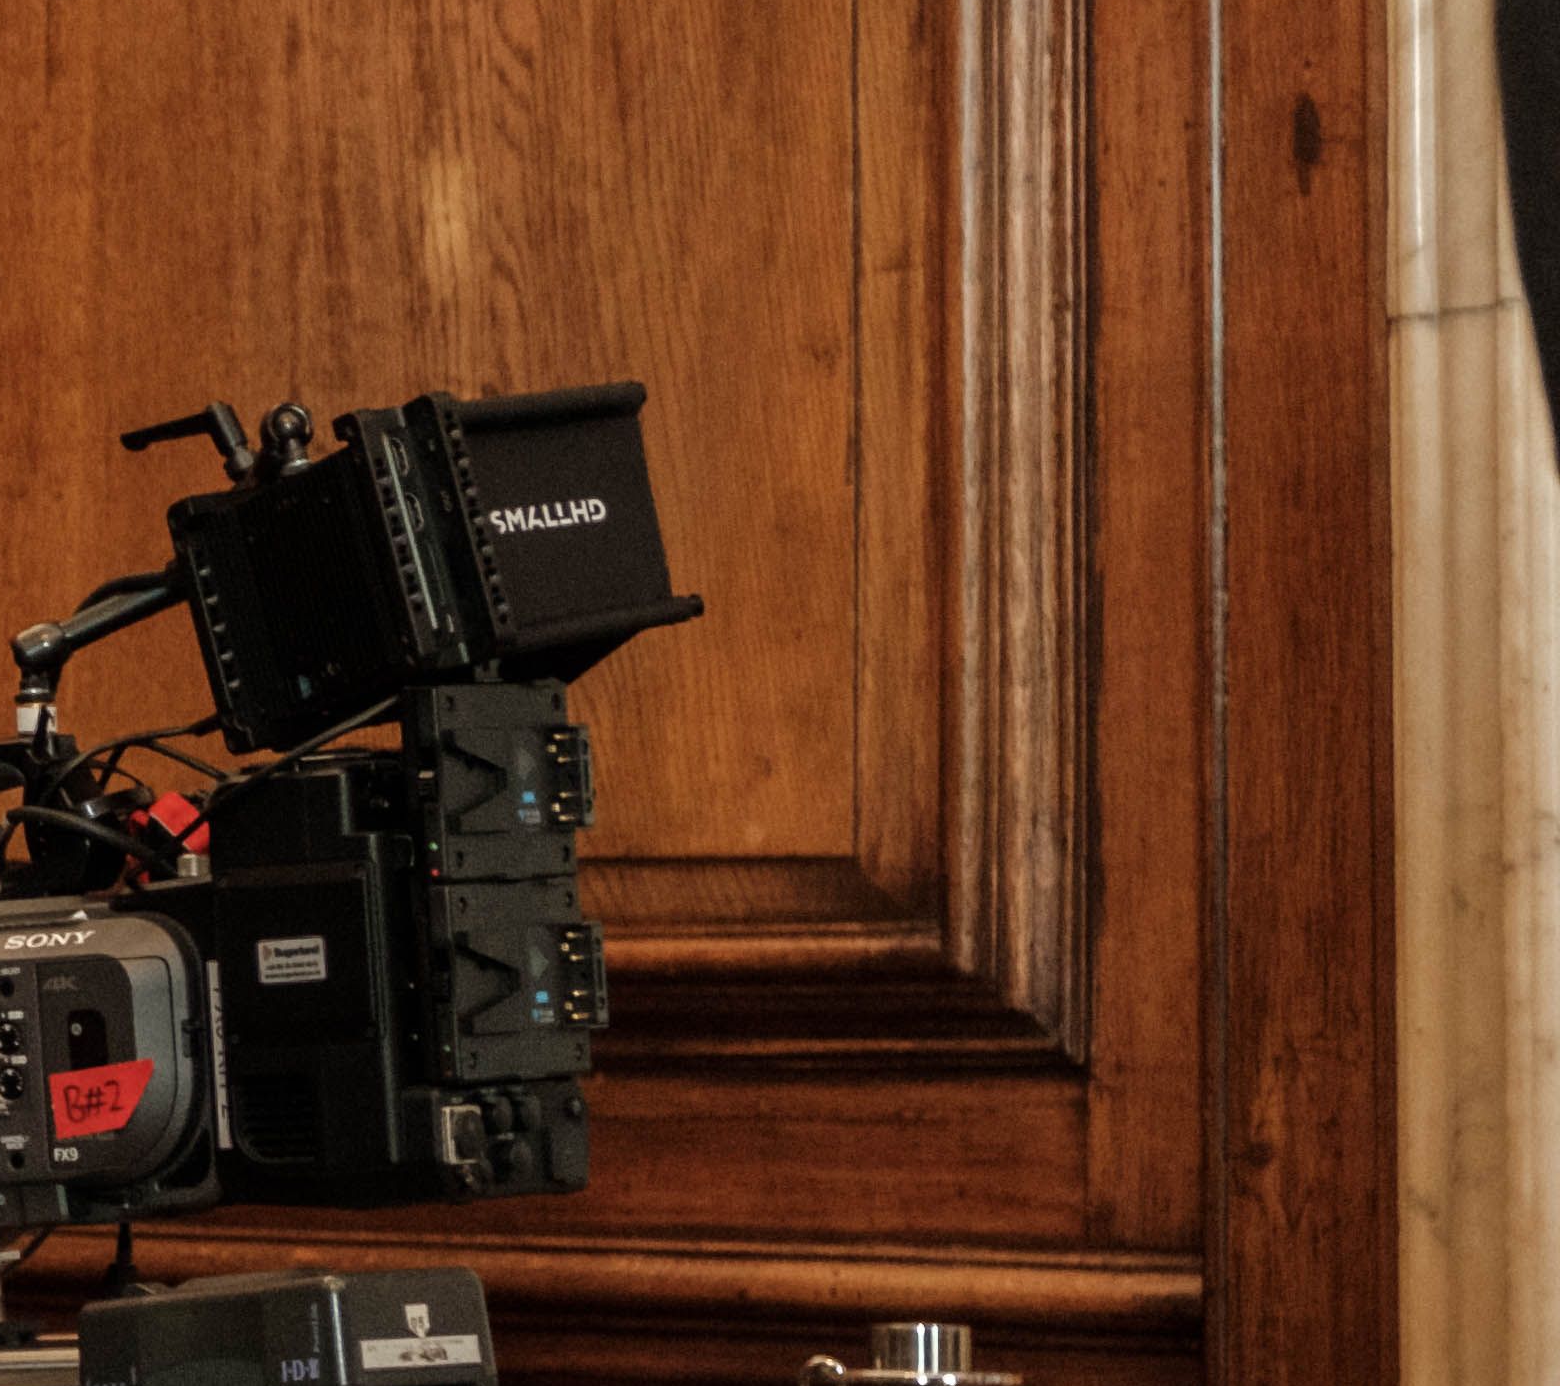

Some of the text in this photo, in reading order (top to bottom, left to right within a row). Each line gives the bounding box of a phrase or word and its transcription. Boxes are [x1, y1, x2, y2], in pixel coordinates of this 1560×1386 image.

[489, 497, 607, 535] SMALLHD
[4, 930, 96, 950] SONY
[63, 1080, 124, 1124] B#2
[53, 1147, 79, 1162] FX9
